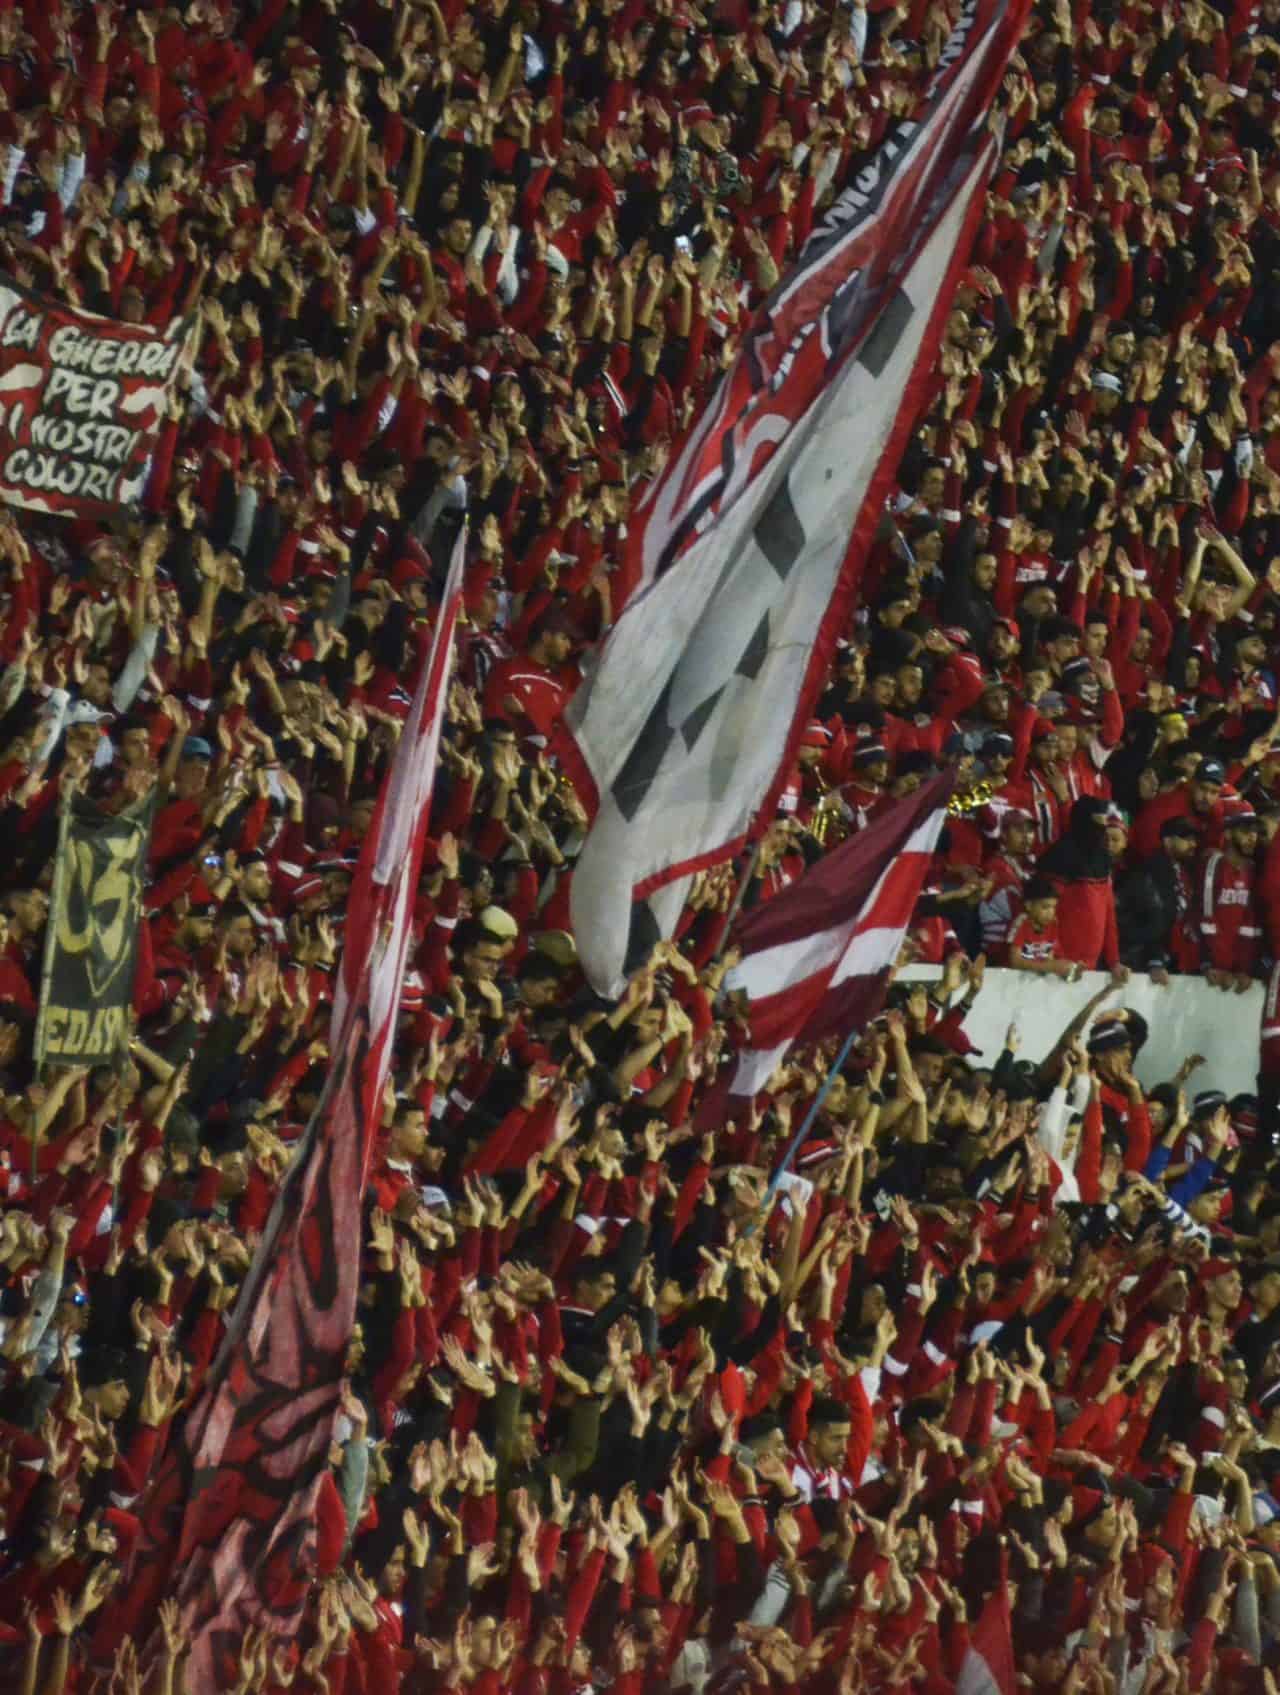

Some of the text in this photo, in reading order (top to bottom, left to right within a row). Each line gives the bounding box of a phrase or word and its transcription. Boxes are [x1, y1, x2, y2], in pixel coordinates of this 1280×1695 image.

[2, 308, 43, 349] LA
[43, 366, 120, 420] PER
[30, 412, 141, 463] NOSTRI
